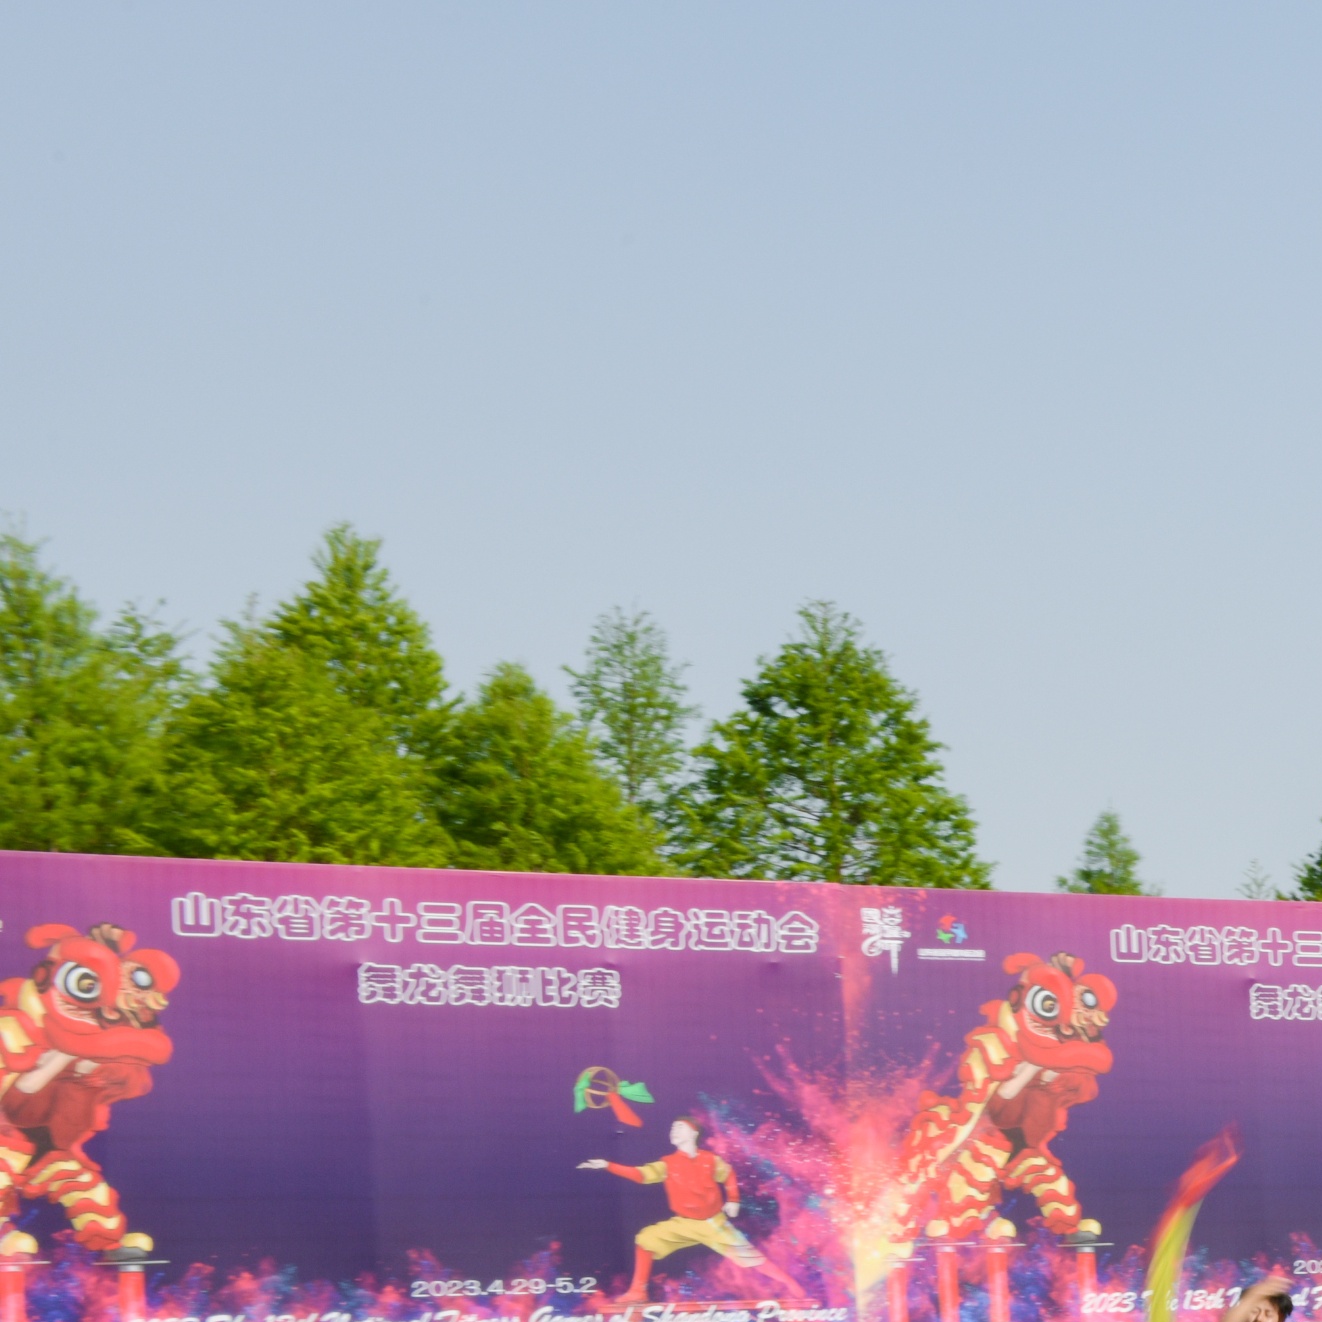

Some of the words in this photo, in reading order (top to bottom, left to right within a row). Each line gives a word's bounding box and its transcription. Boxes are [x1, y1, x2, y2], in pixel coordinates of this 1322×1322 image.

[171, 892, 820, 953] 山东省第十三届全民健身运动会
[357, 962, 622, 1008] 舞龙舞狮比赛
[411, 1276, 598, 1298] 2023.4.29-5.2
[1081, 1291, 1137, 1314] 2023
[1183, 1286, 1226, 1311] 13th
